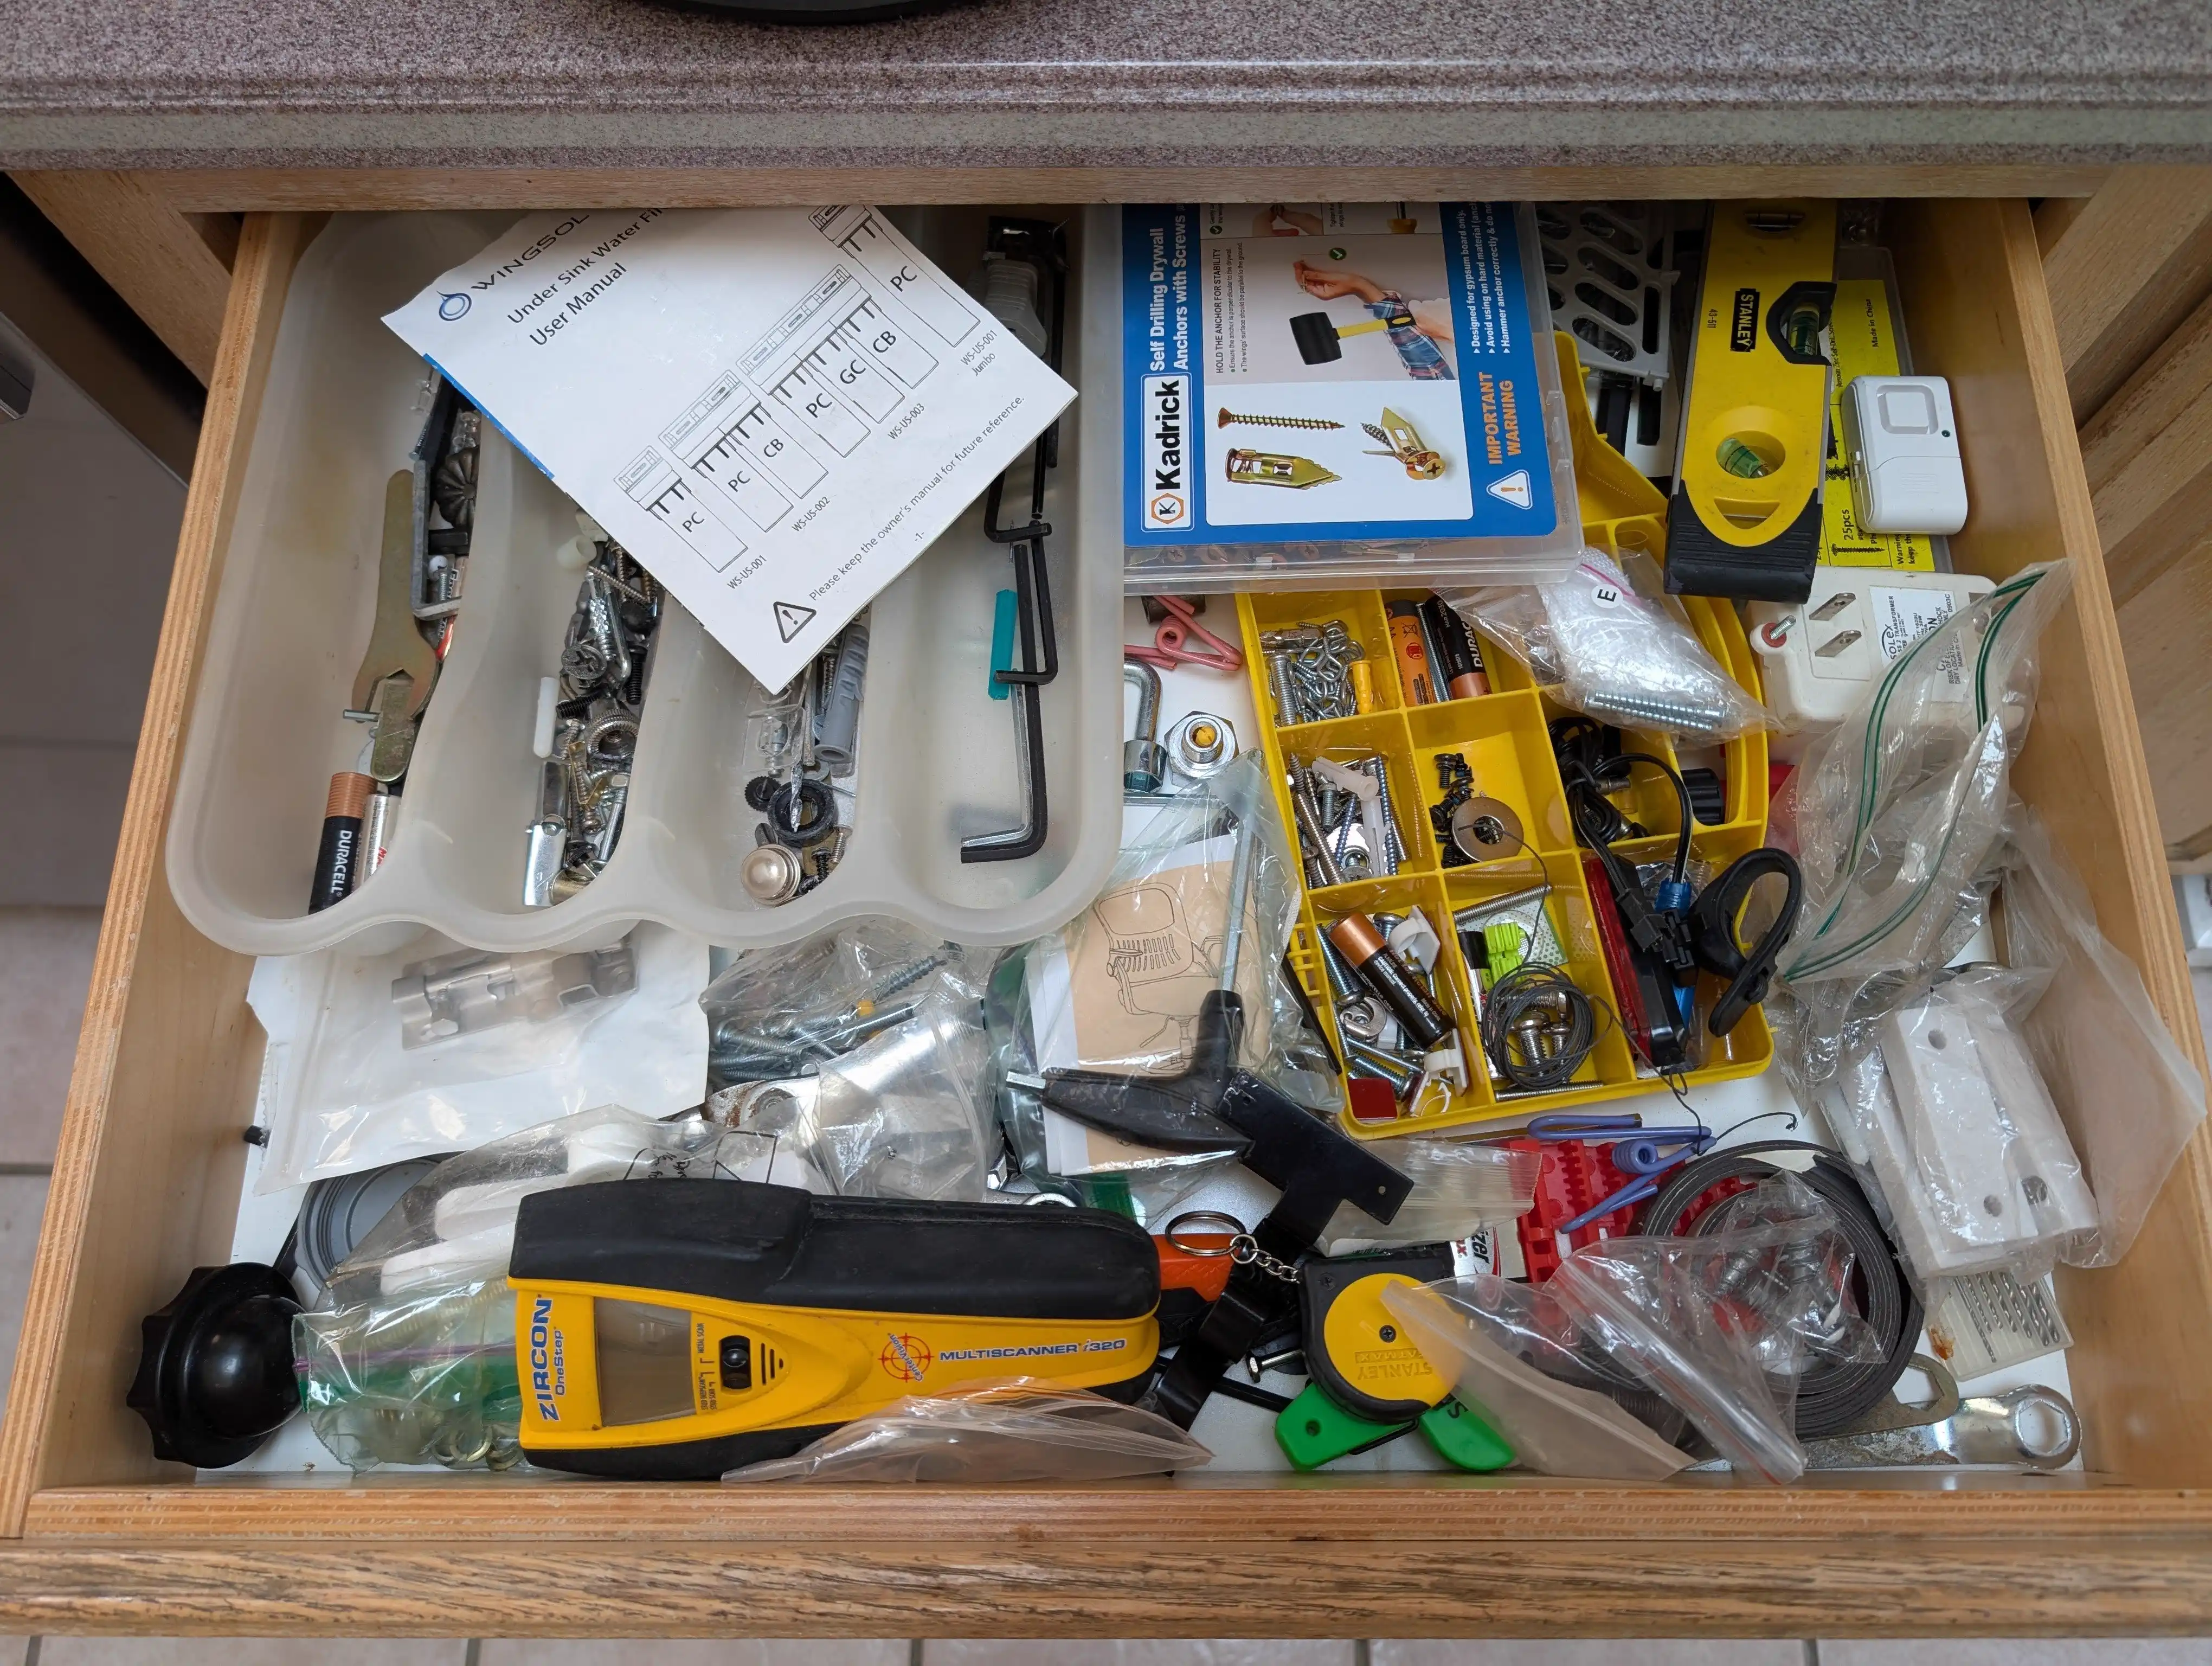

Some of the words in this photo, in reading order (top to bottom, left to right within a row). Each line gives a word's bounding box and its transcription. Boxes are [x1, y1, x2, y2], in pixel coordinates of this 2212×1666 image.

[1485, 215, 1494, 226] do
[471, 214, 590, 290] WINGSOL
[1150, 228, 1167, 281] Drywall
[1173, 215, 1186, 267] Screws
[1458, 230, 1470, 254] board
[1472, 225, 1484, 260] material
[1488, 235, 1501, 275] correctly
[507, 283, 558, 323] Under
[558, 257, 596, 285] Sink
[590, 222, 640, 257] Water
[639, 208, 668, 223] Fil
[890, 264, 919, 292] PC
[1213, 248, 1221, 284] STABILITY
[1463, 257, 1476, 290] gypsum
[1476, 262, 1487, 281] hard
[529, 311, 569, 345] User
[565, 262, 627, 315] Manual
[1173, 271, 1187, 303] with
[1227, 281, 1235, 315] perpendicular
[1466, 292, 1474, 304] for
[1480, 283, 1488, 294] on
[1494, 277, 1506, 307] anchor
[1151, 285, 1167, 336] Drilling
[1214, 302, 1223, 334] ANCHOR
[1481, 296, 1494, 320] using
[1737, 294, 1754, 347] STANLEY
[1865, 298, 1873, 318] China
[1173, 307, 1188, 370] Anchors
[1468, 305, 1481, 347] Designed
[1483, 322, 1495, 347] Avoid
[1497, 309, 1510, 347] Hammer
[1870, 328, 1879, 347] Made
[871, 331, 896, 355] CB
[960, 329, 998, 365] WS-US-001
[1150, 341, 1165, 371] Self
[840, 358, 867, 383] GC
[971, 353, 995, 376] Jumbo
[1216, 352, 1224, 374] HOLD
[806, 392, 834, 418] PC
[887, 403, 924, 439] WS-US-003
[1478, 371, 1502, 464] IMPORTANT
[1499, 380, 1521, 456] WARNING
[764, 439, 783, 457] CB
[1155, 380, 1181, 489] Kadrick
[728, 471, 750, 492] PC
[791, 496, 830, 531] WS-US-002
[809, 574, 840, 600] Please
[837, 553, 861, 575] keep
[860, 538, 878, 553] the
[878, 505, 911, 538] owner's
[910, 472, 943, 506] manual
[941, 460, 956, 475] for
[954, 436, 983, 461] future
[982, 397, 1024, 437] reference.
[683, 512, 704, 533] PC
[1841, 509, 1854, 541] 25pcs
[726, 555, 767, 589] WS-US-001
[1437, 600, 1447, 616] 2030
[1597, 588, 1617, 603] E
[1889, 596, 1899, 637] TRANSFORMER
[1462, 621, 1483, 667] DURAC
[1373, 959, 1385, 972] device
[1377, 955, 1394, 975] CAUTION:
[1392, 972, 1406, 989] Connect
[531, 1299, 560, 1421] ZIRCON
[554, 1330, 565, 1395] OneStep
[890, 1334, 923, 1381] CenterVision
[940, 1344, 1077, 1360] MULTISCANNER
[1083, 1340, 1126, 1351] i320
[1358, 1363, 1432, 1380] STANLEY
